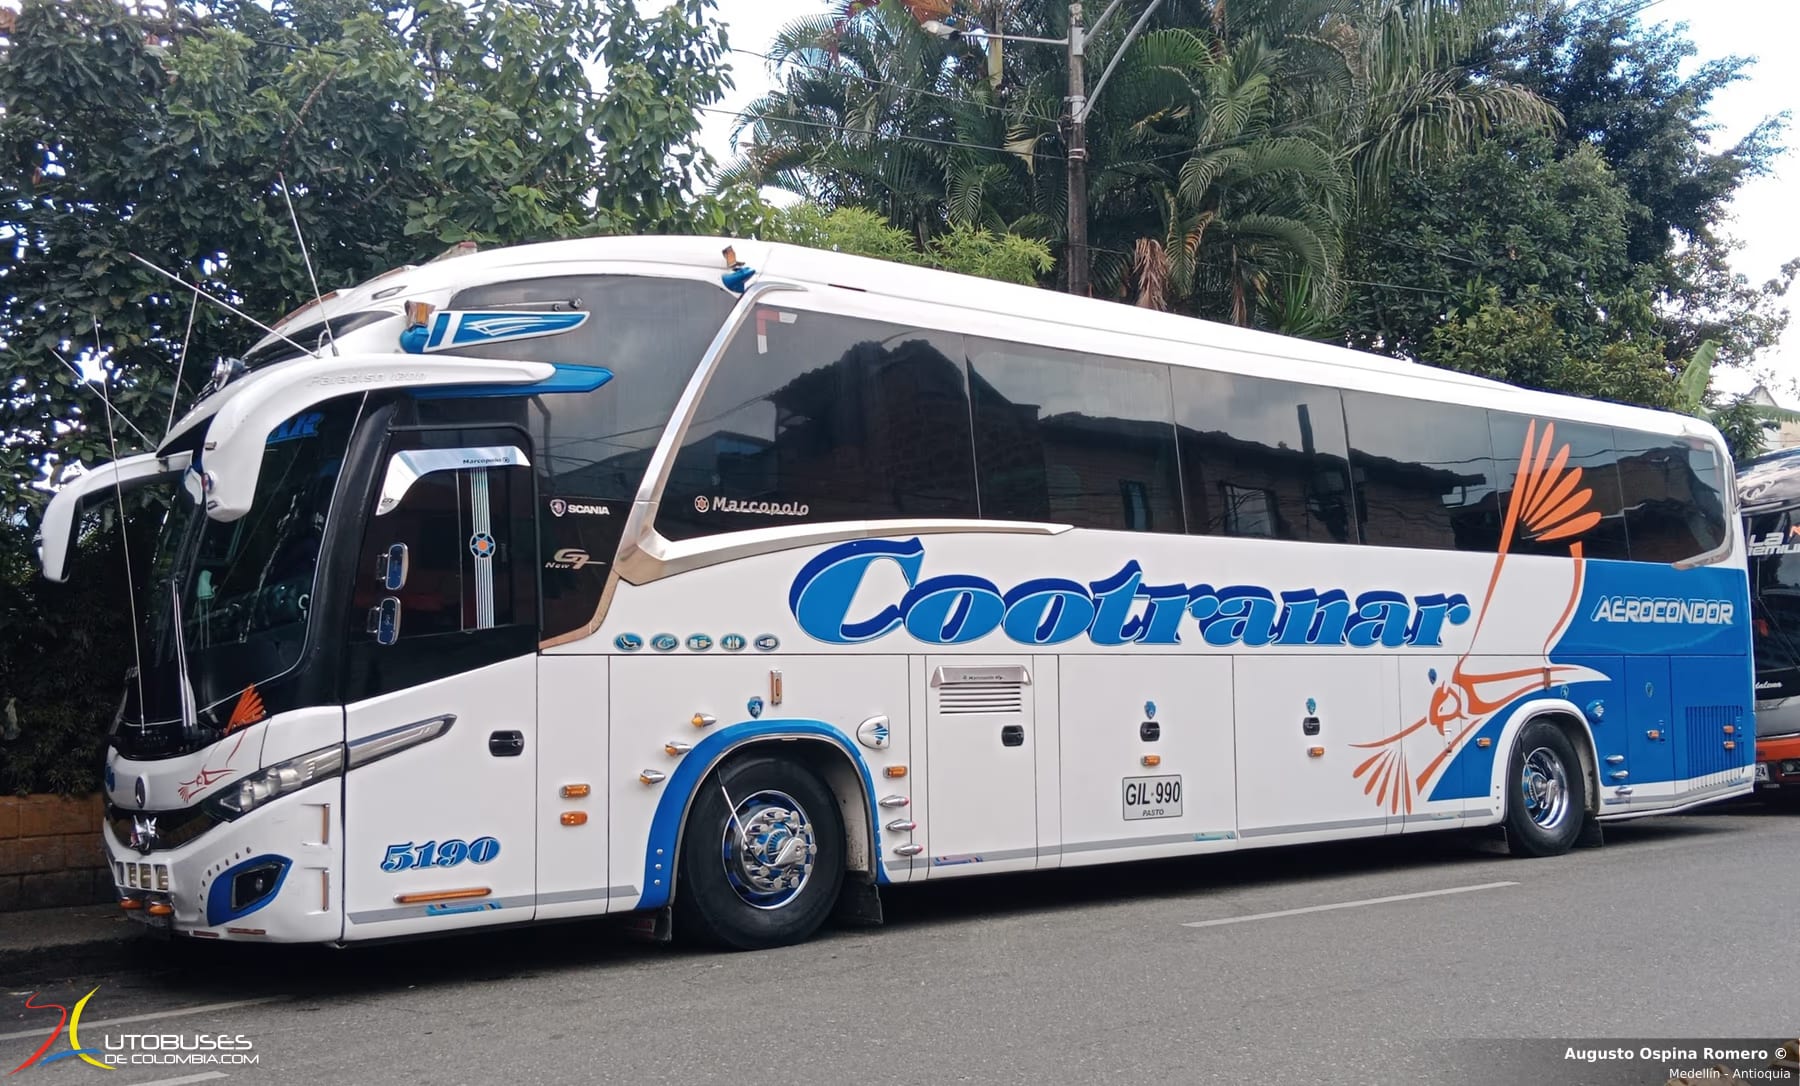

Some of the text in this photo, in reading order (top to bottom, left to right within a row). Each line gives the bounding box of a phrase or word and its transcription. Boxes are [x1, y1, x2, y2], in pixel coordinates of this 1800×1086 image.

[568, 504, 610, 516] SCANIA
[712, 496, 809, 516] Marcopolo
[789, 536, 1470, 646] Cootranar
[1590, 595, 1733, 625] AEROCONDOR
[1142, 809, 1165, 817] PASTO
[380, 836, 500, 873] 5190
